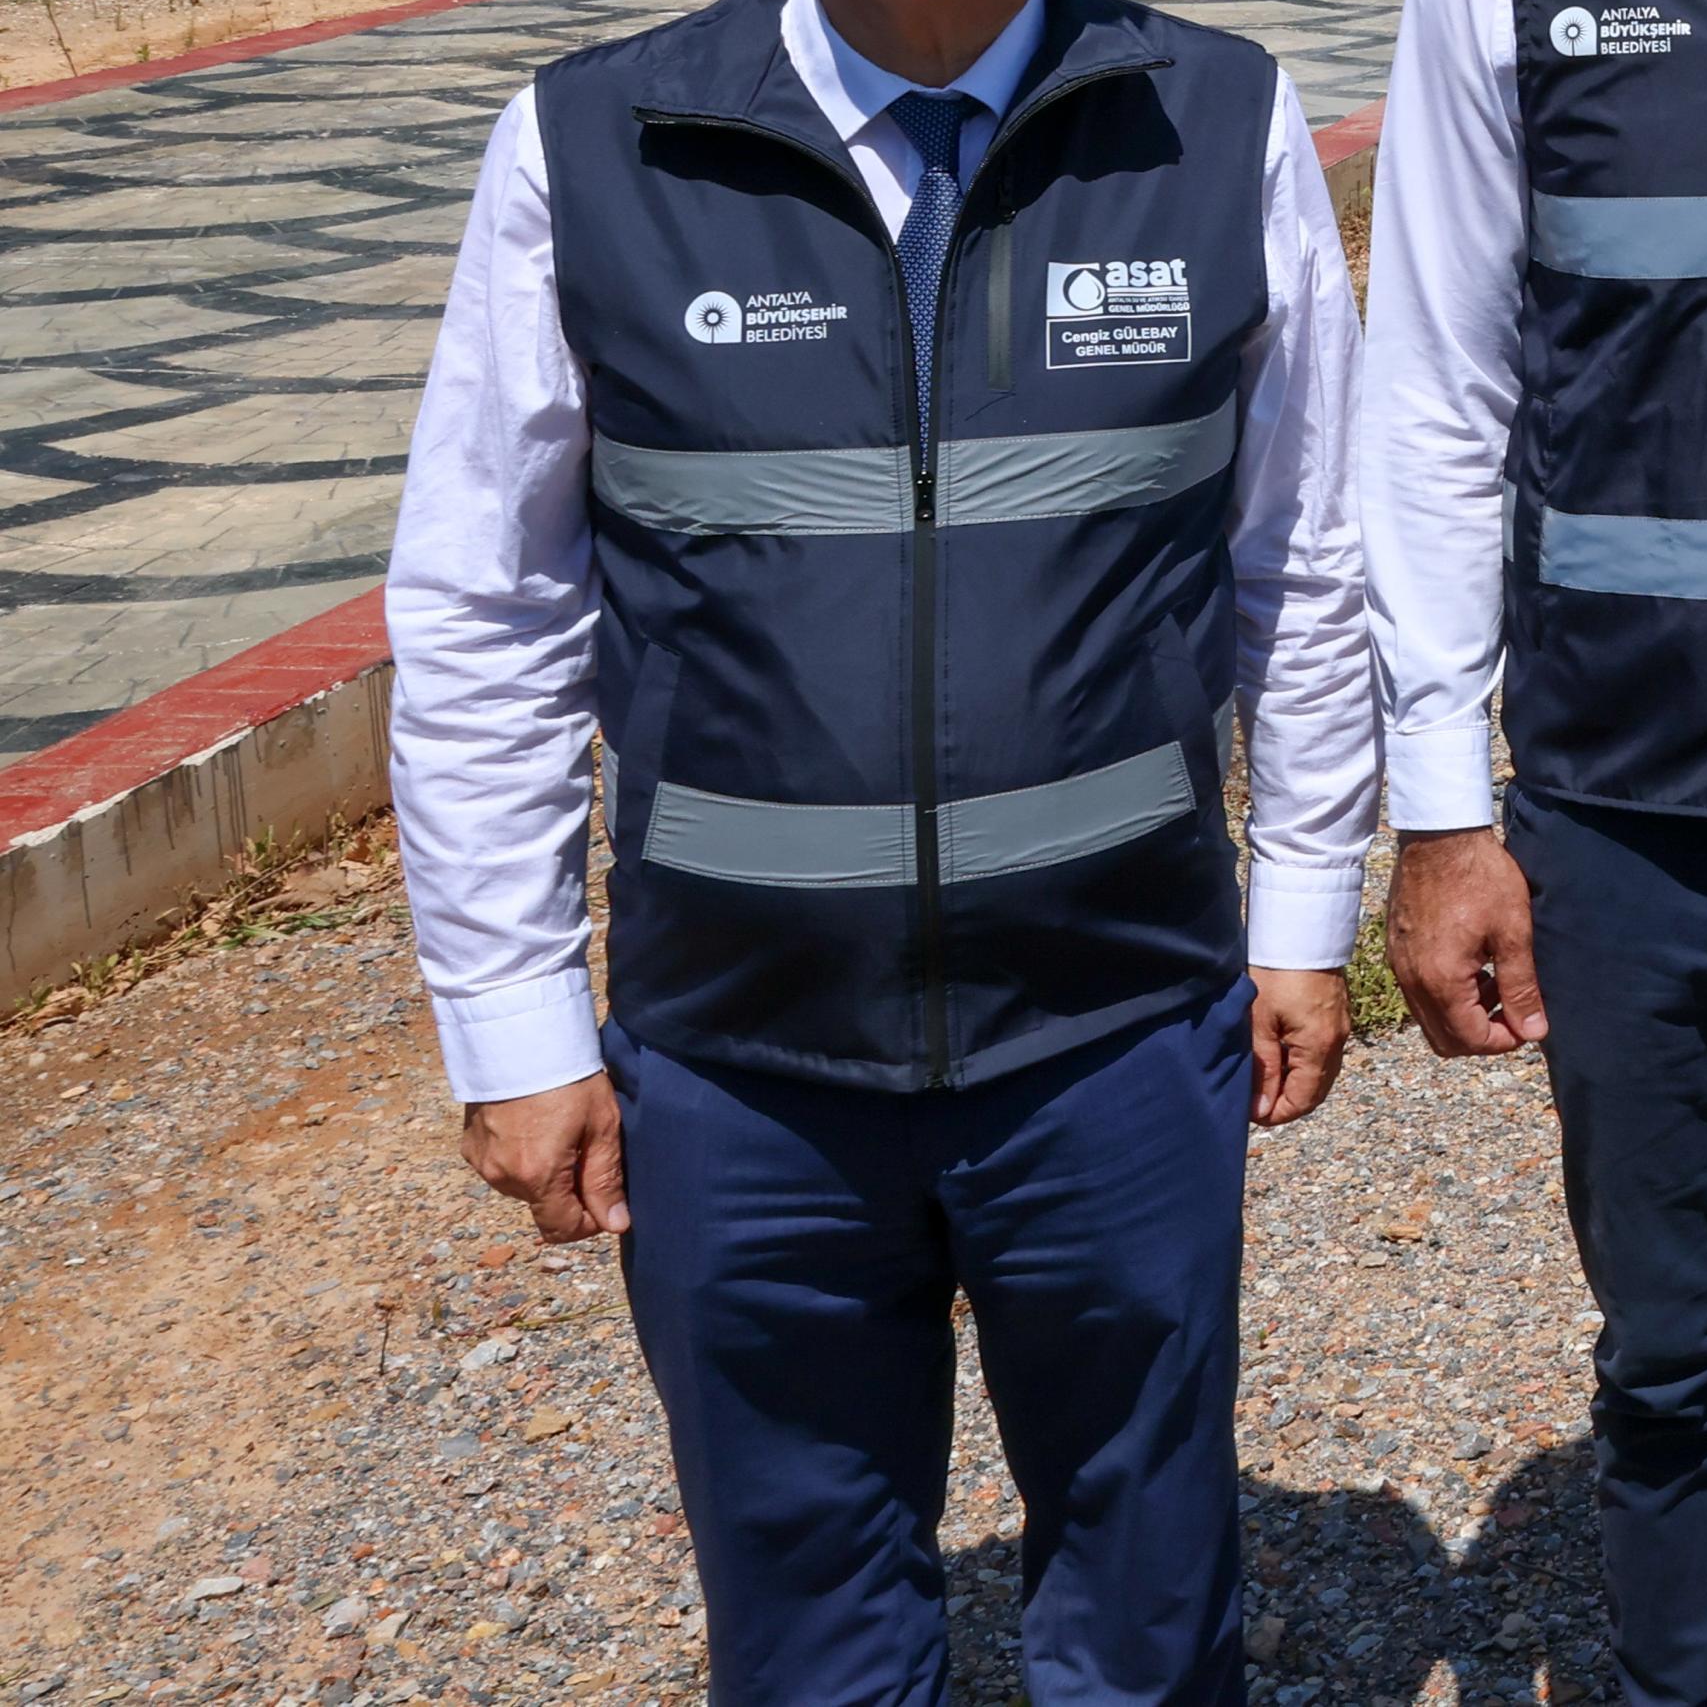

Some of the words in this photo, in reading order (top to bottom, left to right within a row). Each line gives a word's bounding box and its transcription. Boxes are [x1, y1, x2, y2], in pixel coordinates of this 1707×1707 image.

[1600, 6, 1660, 22] ANTALYA
[1600, 19, 1692, 38] BÜYÜKŞEHİR
[1600, 37, 1671, 55] BELEDİYESİ
[1105, 258, 1188, 287] asat
[746, 291, 813, 308] ANTALYA
[1108, 304, 1135, 313] GENEL
[746, 303, 848, 325] BÜYÜKŞEHİR
[746, 322, 827, 343] BELEDİYESİ
[1062, 329, 1110, 344] Cengiz
[1113, 326, 1178, 340] GÜLEBAY
[1075, 345, 1120, 357] GENEL
[1121, 342, 1166, 354] MÜDÜR
